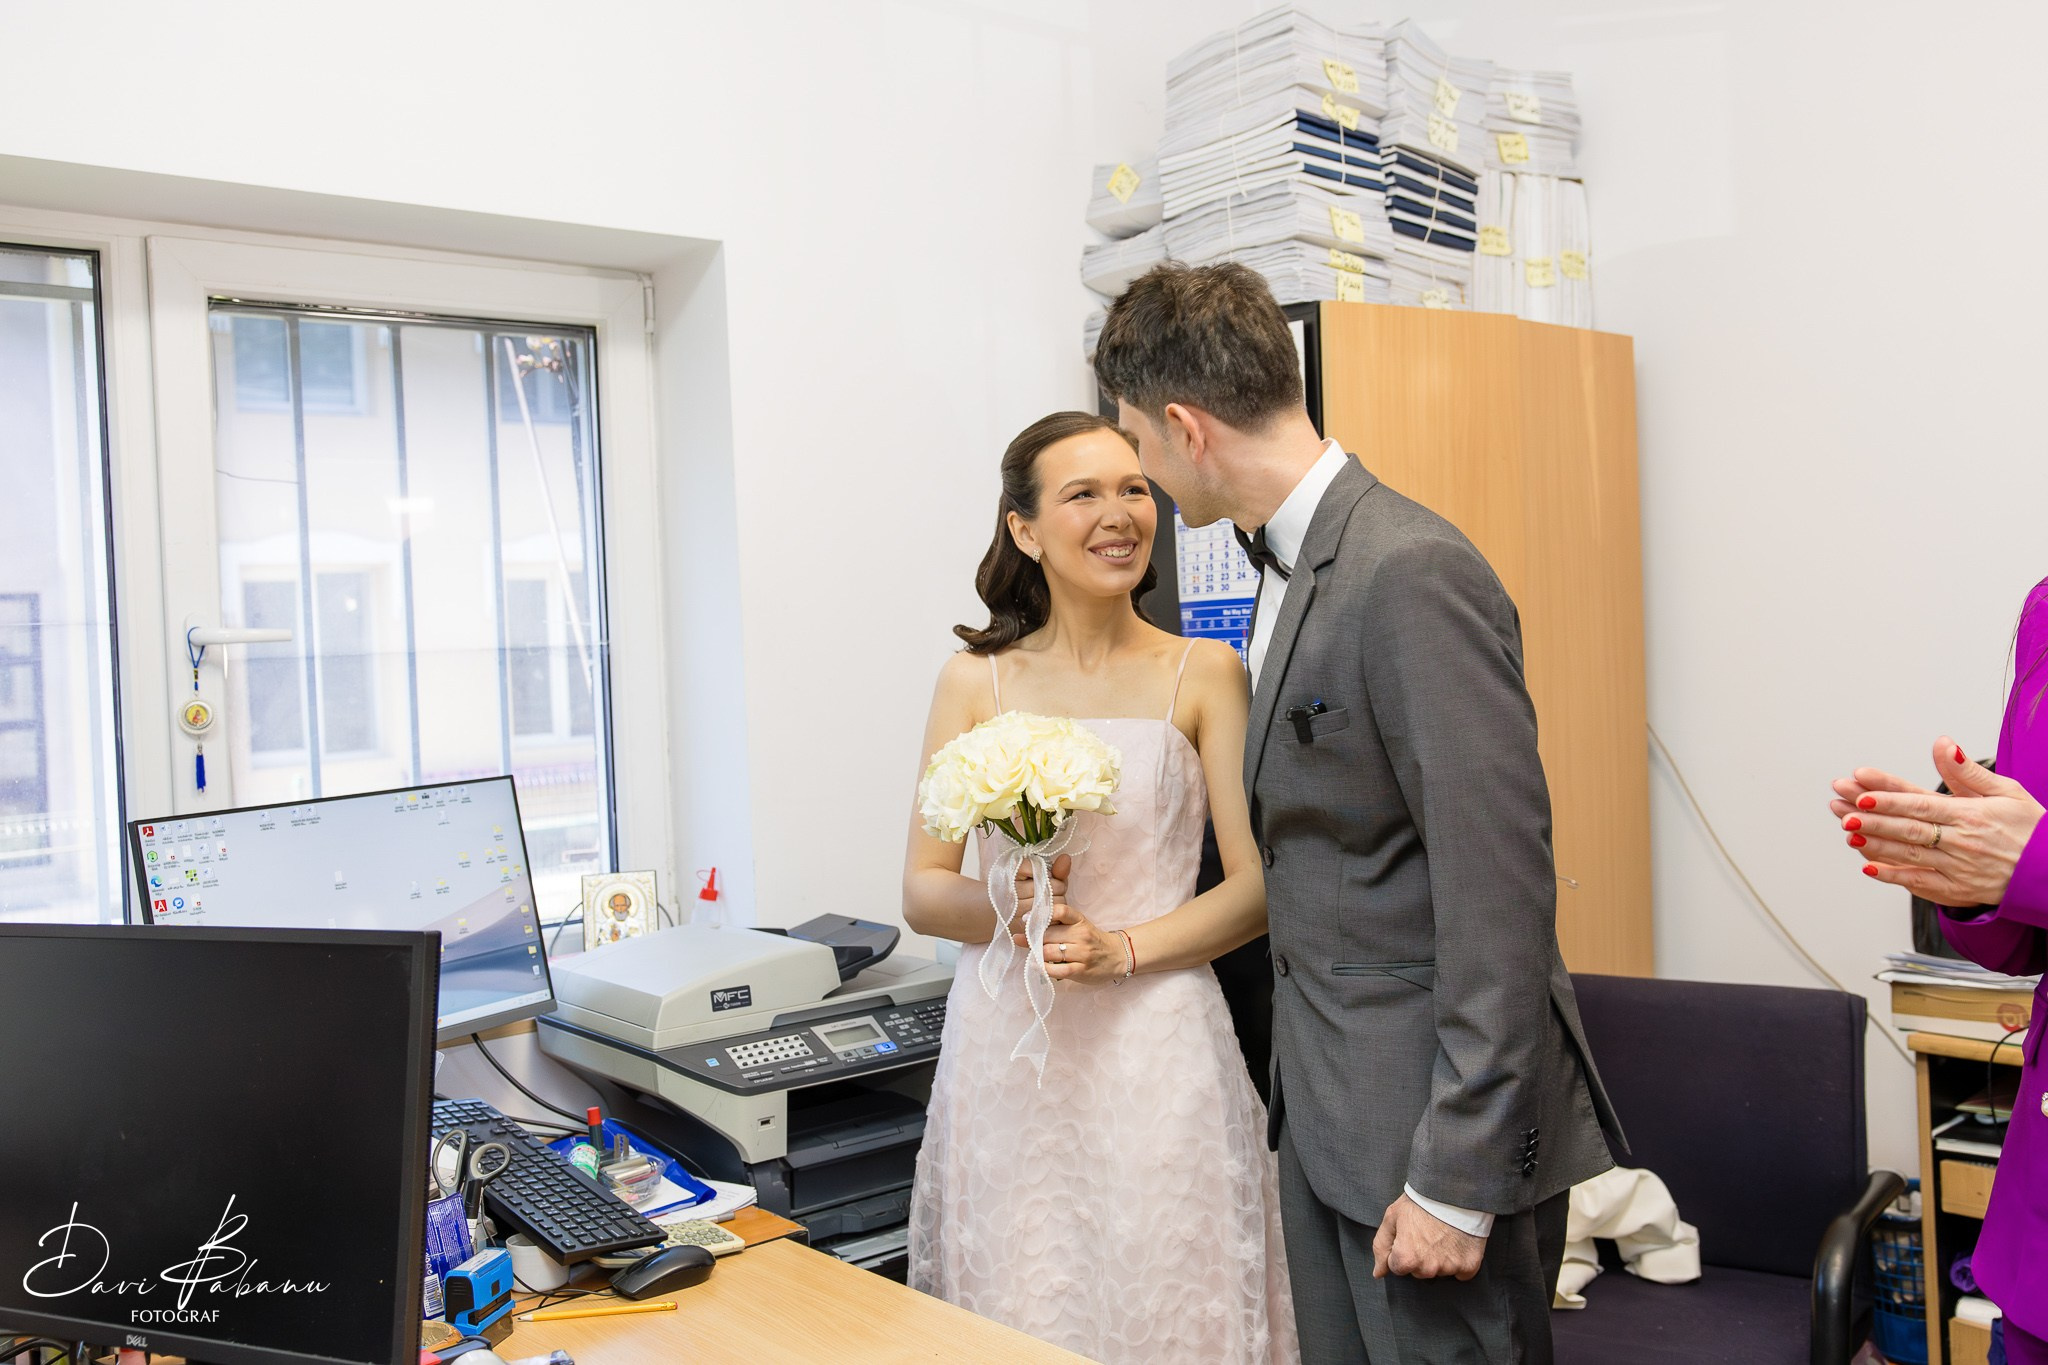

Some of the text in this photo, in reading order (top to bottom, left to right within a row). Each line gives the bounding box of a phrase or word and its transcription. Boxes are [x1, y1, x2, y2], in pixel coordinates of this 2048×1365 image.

[1206, 563, 1213, 571] 15
[1221, 562, 1229, 570] 16
[1237, 560, 1245, 568] 17
[1193, 575, 1199, 583] 21
[1206, 574, 1213, 582] 22
[1237, 571, 1246, 579] 24
[1193, 583, 1229, 593] 28 29 30
[713, 989, 749, 1003] MFC
[126, 1334, 148, 1348] DELL
